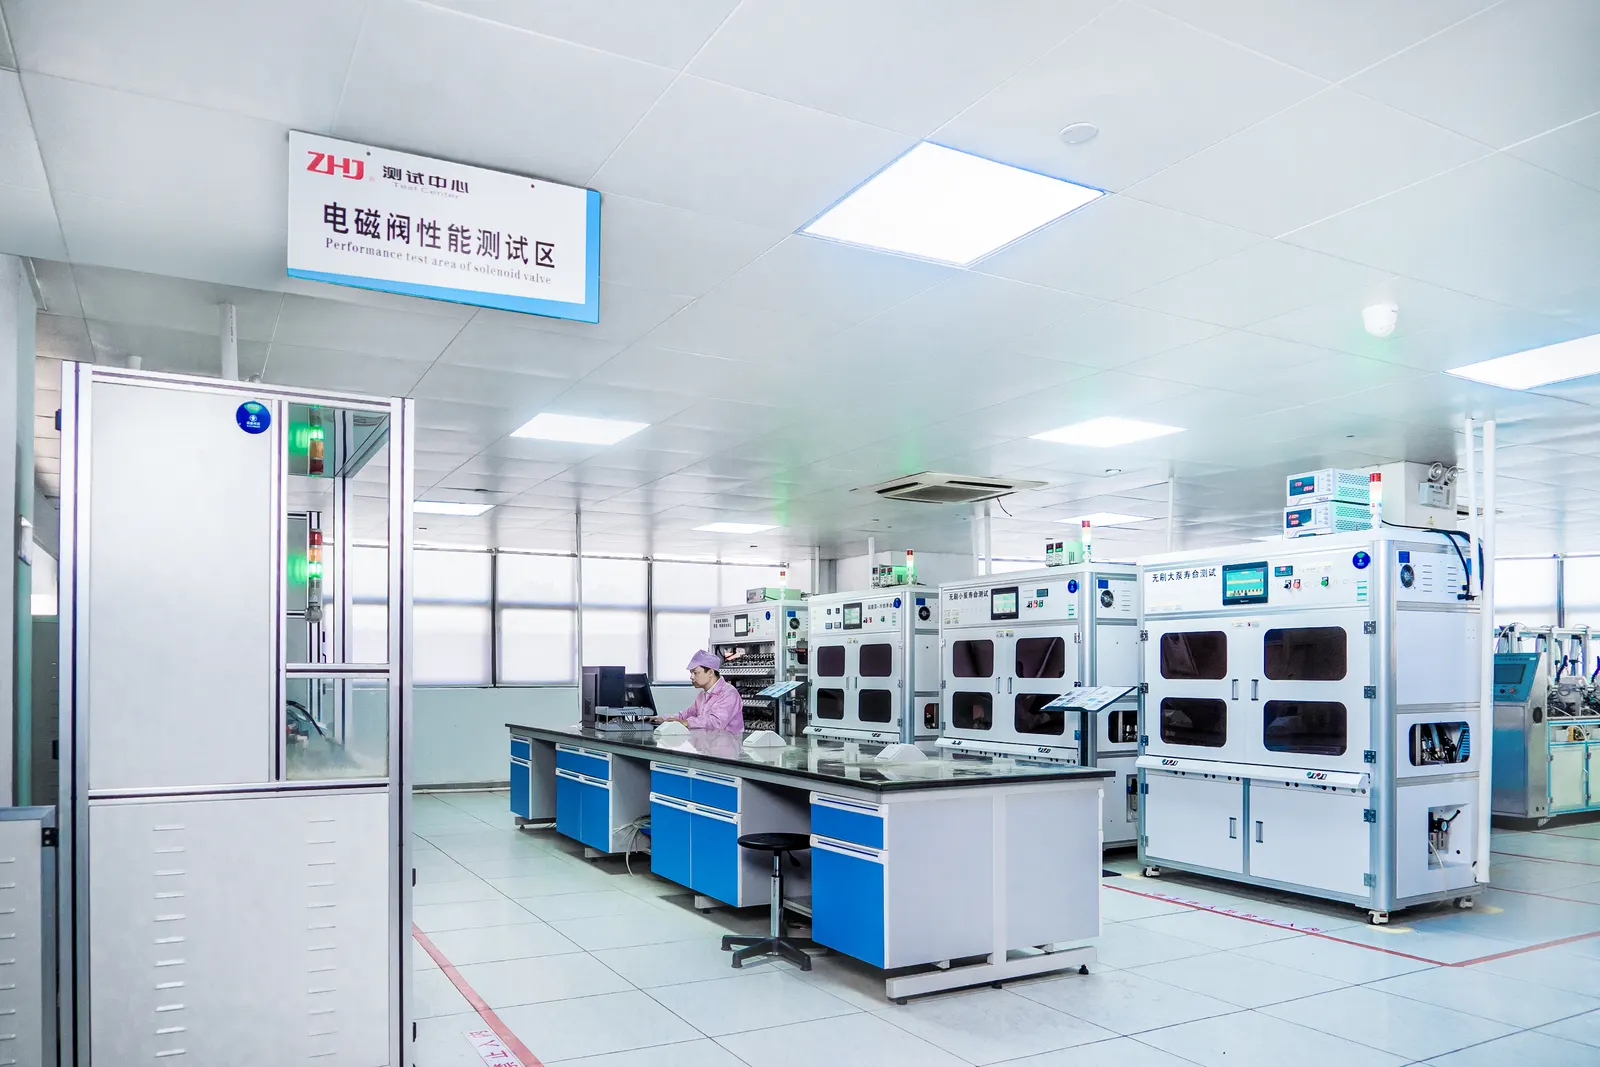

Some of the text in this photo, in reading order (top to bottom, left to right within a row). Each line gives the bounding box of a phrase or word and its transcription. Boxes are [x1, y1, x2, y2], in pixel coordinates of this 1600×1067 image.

[382, 165, 470, 194] 测试中心
[392, 181, 459, 199] Test Center
[323, 201, 556, 269] 电磁阀性能测试区
[325, 237, 552, 285] Performance test area of solenoid valve
